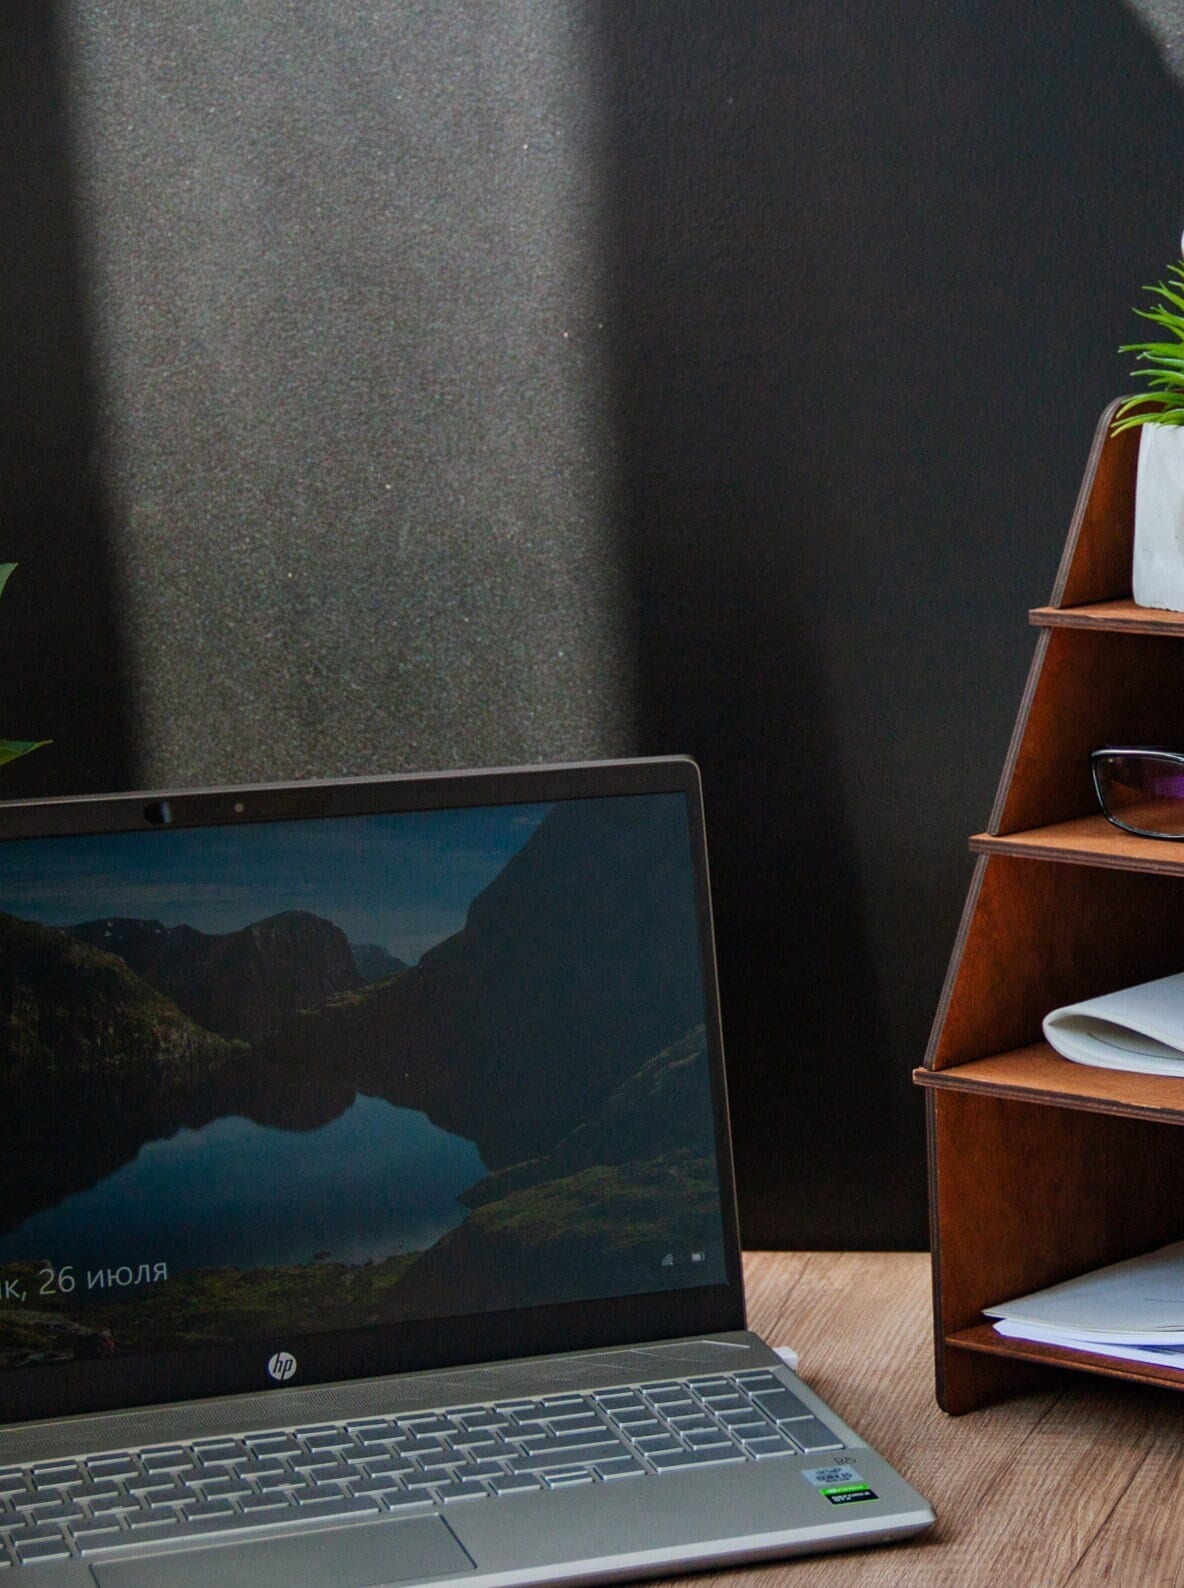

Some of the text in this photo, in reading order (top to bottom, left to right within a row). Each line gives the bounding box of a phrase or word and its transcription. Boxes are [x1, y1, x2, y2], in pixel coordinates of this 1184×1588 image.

[0, 1262, 168, 1302] к, 26 июля
[270, 1352, 296, 1380] hp
